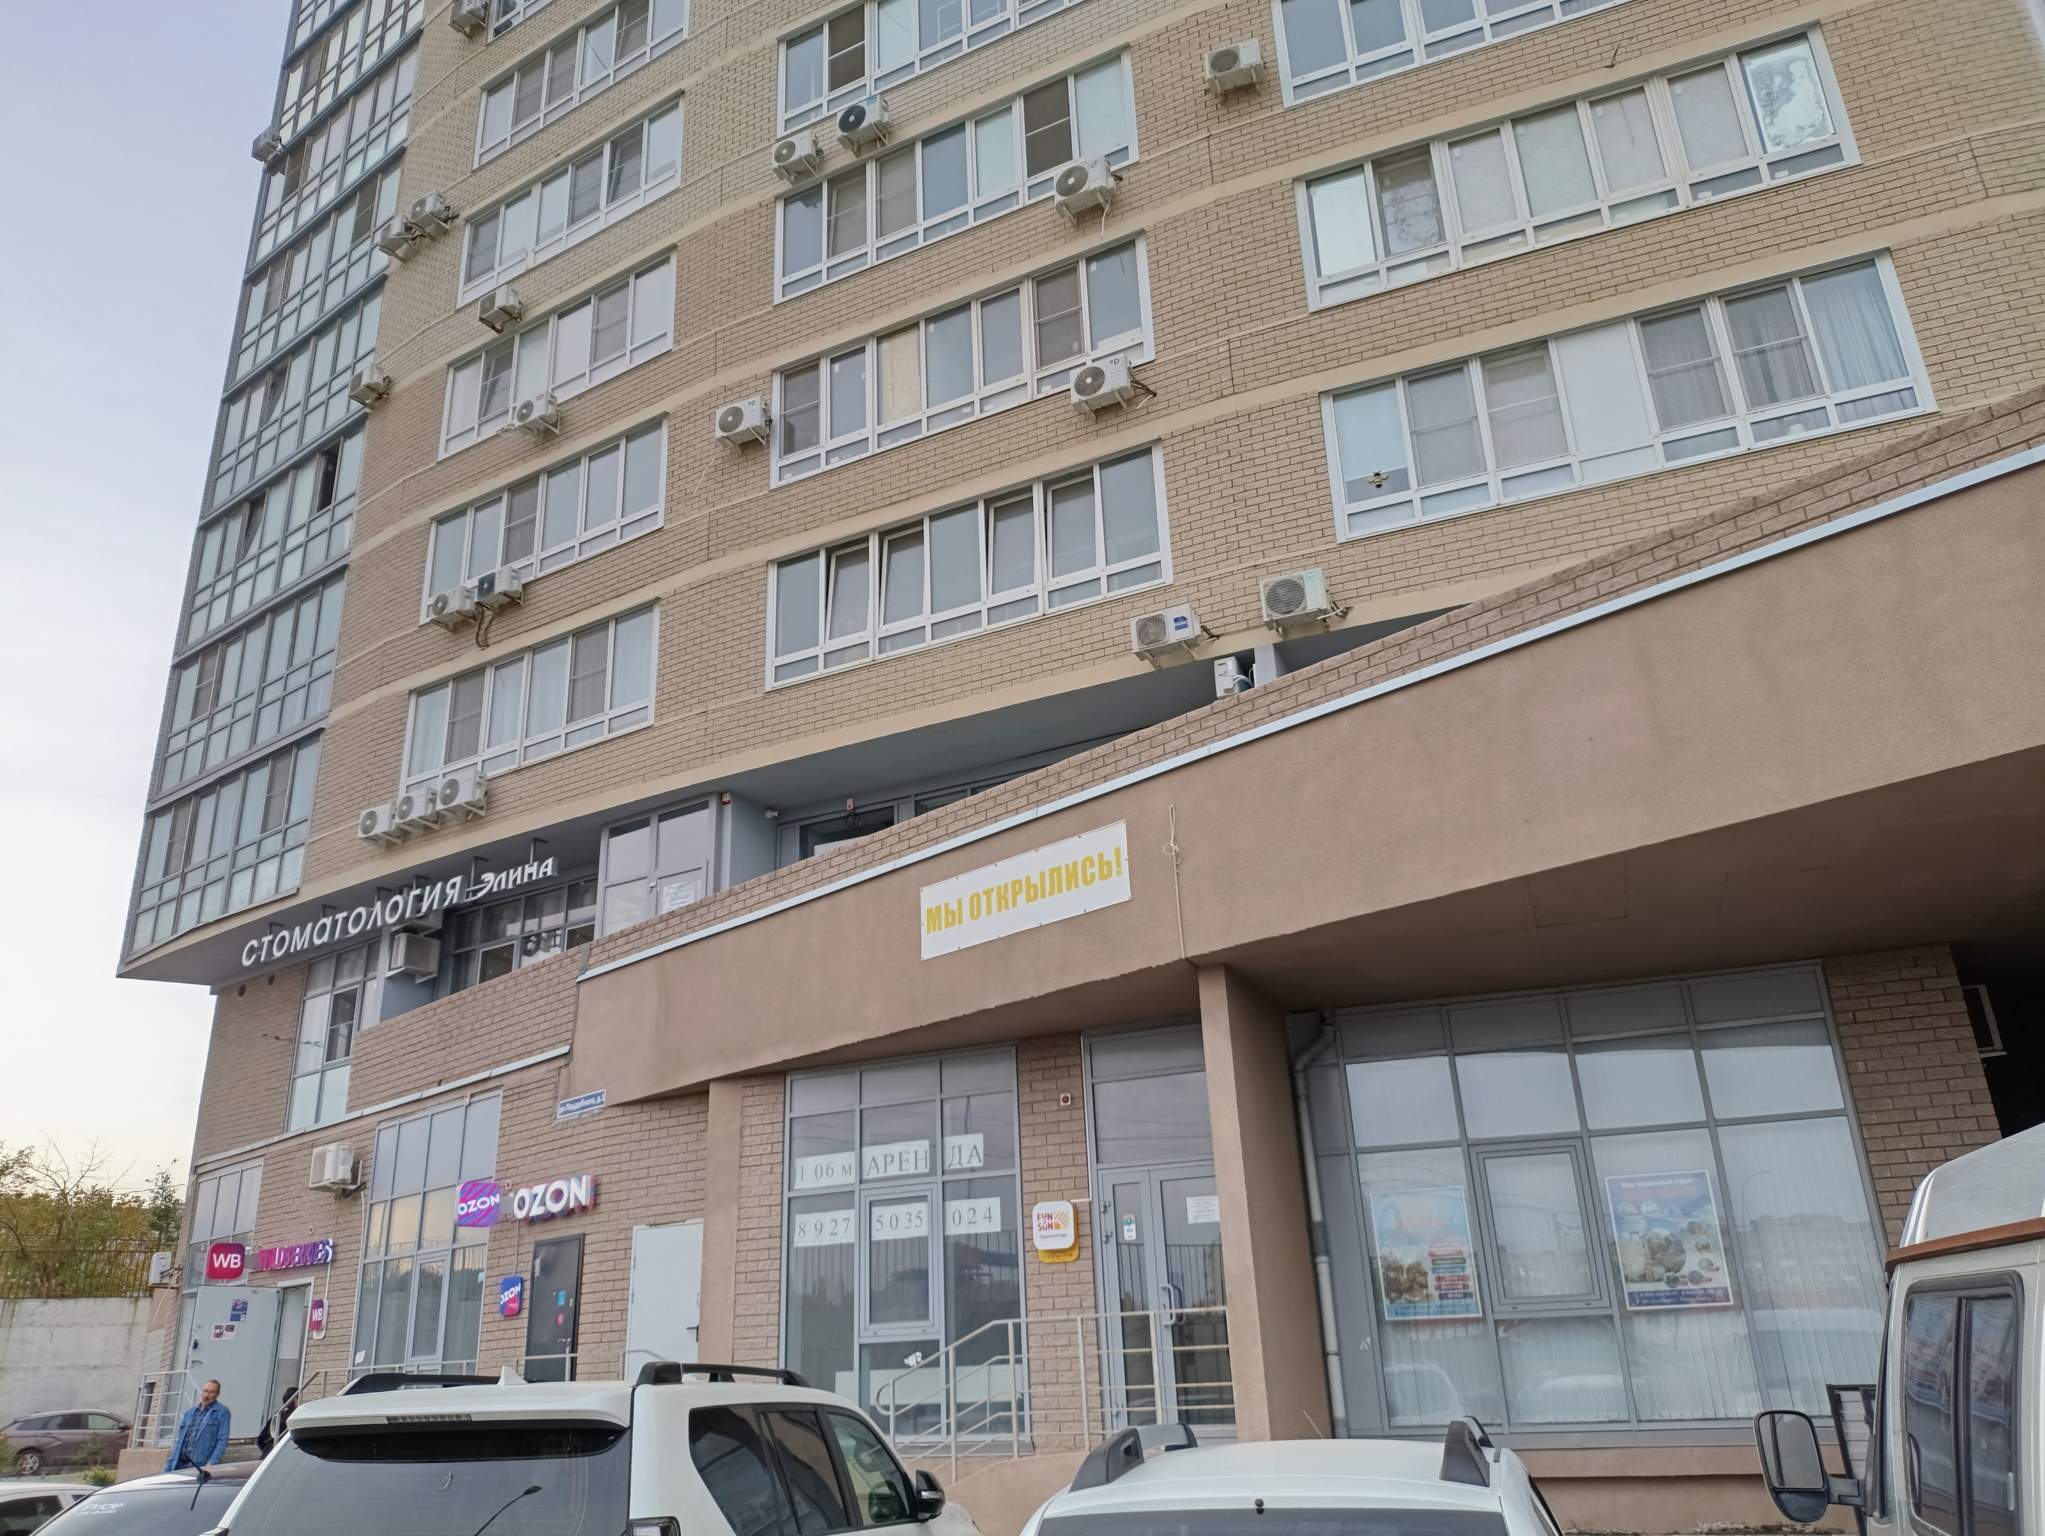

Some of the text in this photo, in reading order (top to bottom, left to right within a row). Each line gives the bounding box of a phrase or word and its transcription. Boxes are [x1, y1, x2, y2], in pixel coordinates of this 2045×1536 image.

[926, 846, 1122, 934] МЫ ОТКРЫЛИСЬ!
[458, 1193, 500, 1215] OZON
[513, 1174, 592, 1220] OZON
[797, 1206, 993, 1239] 8927 5035 024
[212, 1252, 242, 1269] WB
[500, 1283, 522, 1305] OZON
[312, 1308, 323, 1322] WB
